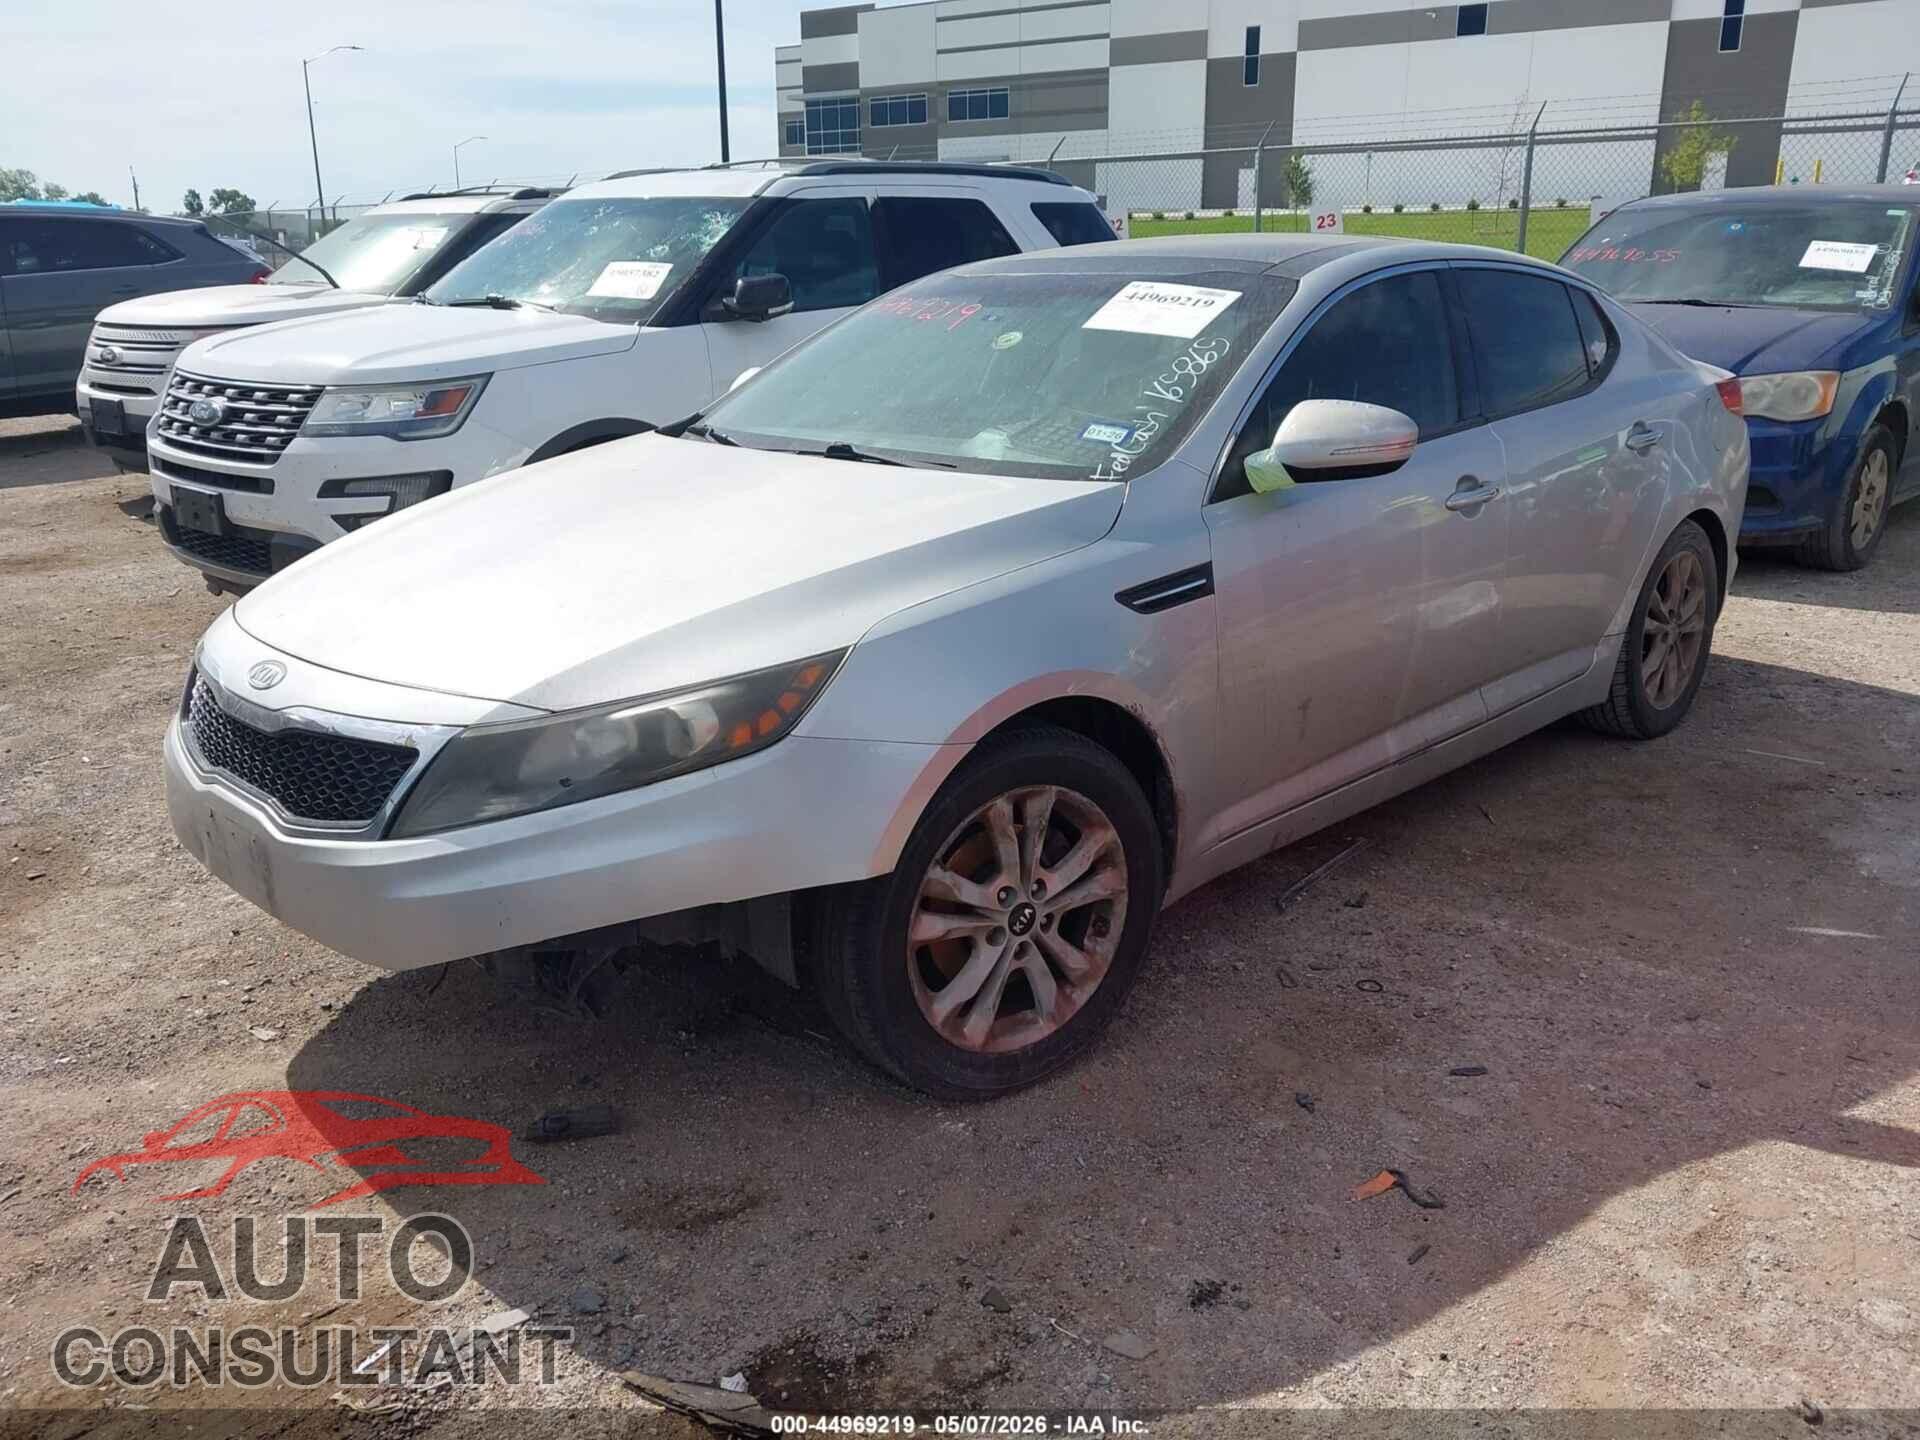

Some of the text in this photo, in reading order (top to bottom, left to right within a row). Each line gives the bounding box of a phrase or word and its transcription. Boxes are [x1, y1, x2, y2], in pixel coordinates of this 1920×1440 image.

[1317, 213, 1337, 229] 23
[1125, 291, 1216, 308] 44969219
[1012, 908, 1034, 933] KIA
